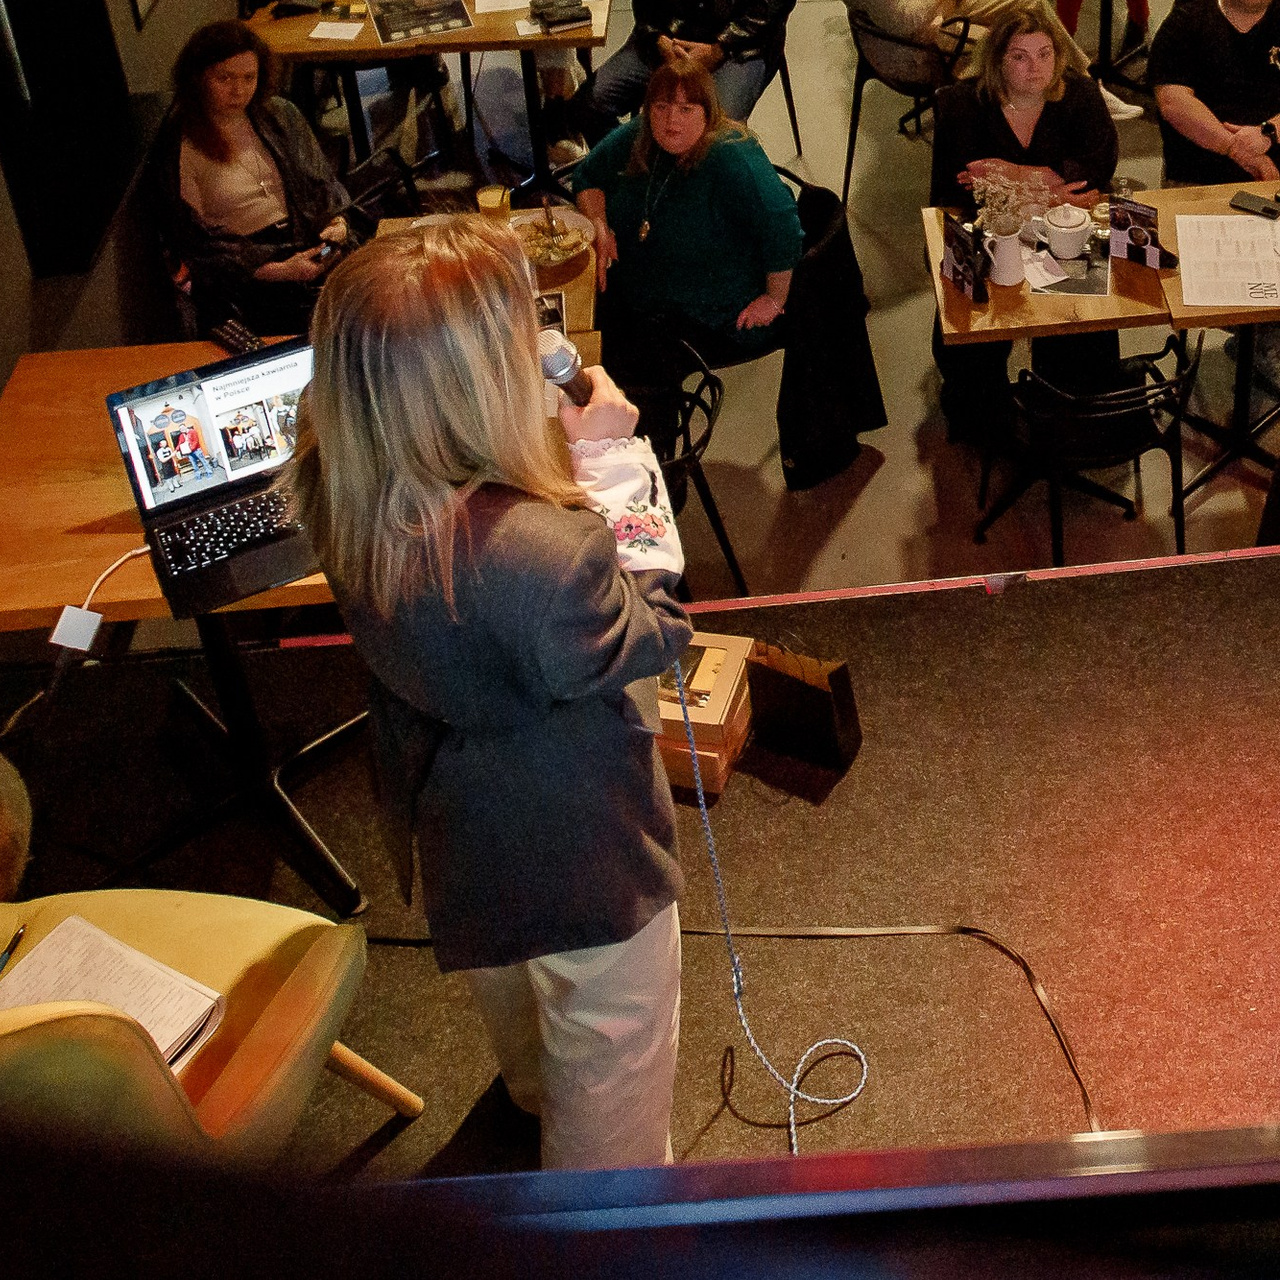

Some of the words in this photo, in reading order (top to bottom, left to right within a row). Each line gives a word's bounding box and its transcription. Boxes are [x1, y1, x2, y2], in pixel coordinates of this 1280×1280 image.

[1247, 282, 1265, 299] NU
[1262, 282, 1279, 299] ME
[212, 373, 260, 393] Najmniejsza
[261, 361, 298, 376] kawiarnia
[223, 386, 250, 398] Polsce
